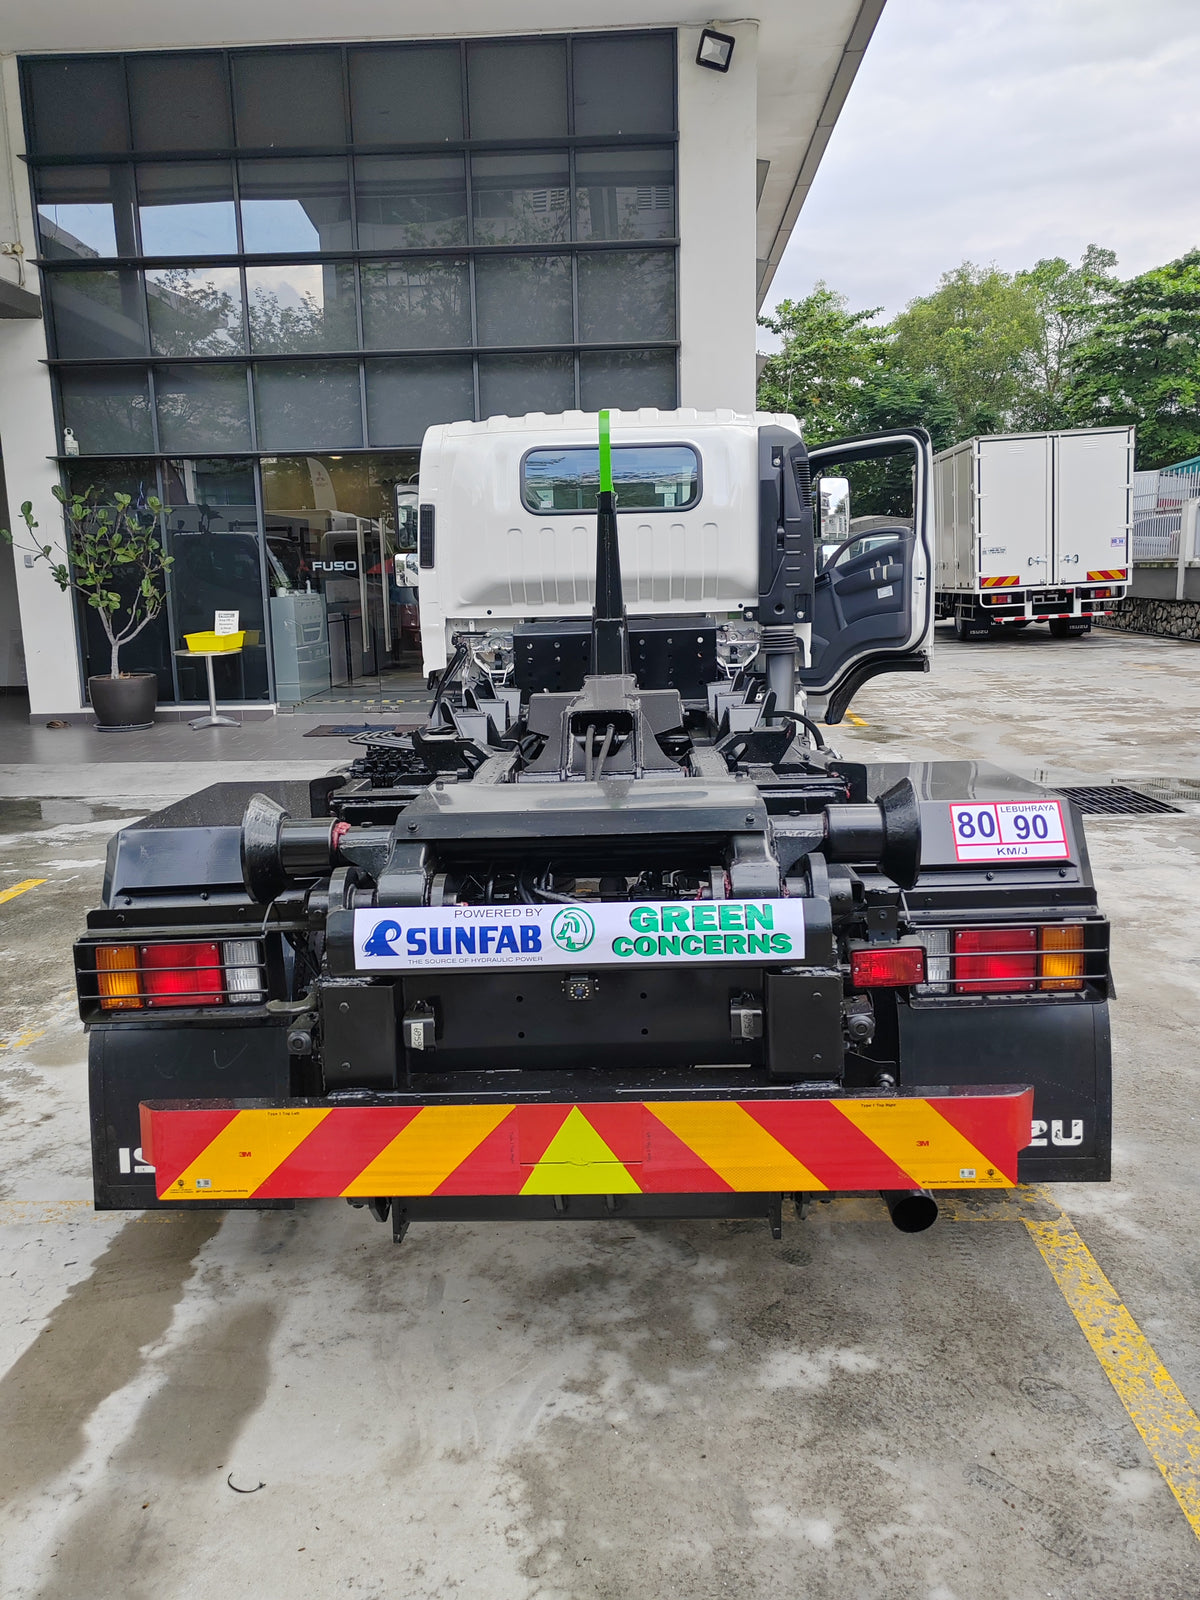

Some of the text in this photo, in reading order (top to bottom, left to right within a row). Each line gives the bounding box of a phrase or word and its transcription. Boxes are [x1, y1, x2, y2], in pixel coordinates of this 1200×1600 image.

[312, 561, 357, 571] FUSO
[1000, 804, 1055, 813] LEBUHRAYA
[957, 811, 1048, 839] 80 90
[996, 847, 1028, 855] KM/J
[454, 908, 543, 918] POWERED BY
[629, 904, 774, 933] GREEN
[406, 925, 542, 955] SUNFAB
[612, 933, 793, 957] CONCERNS
